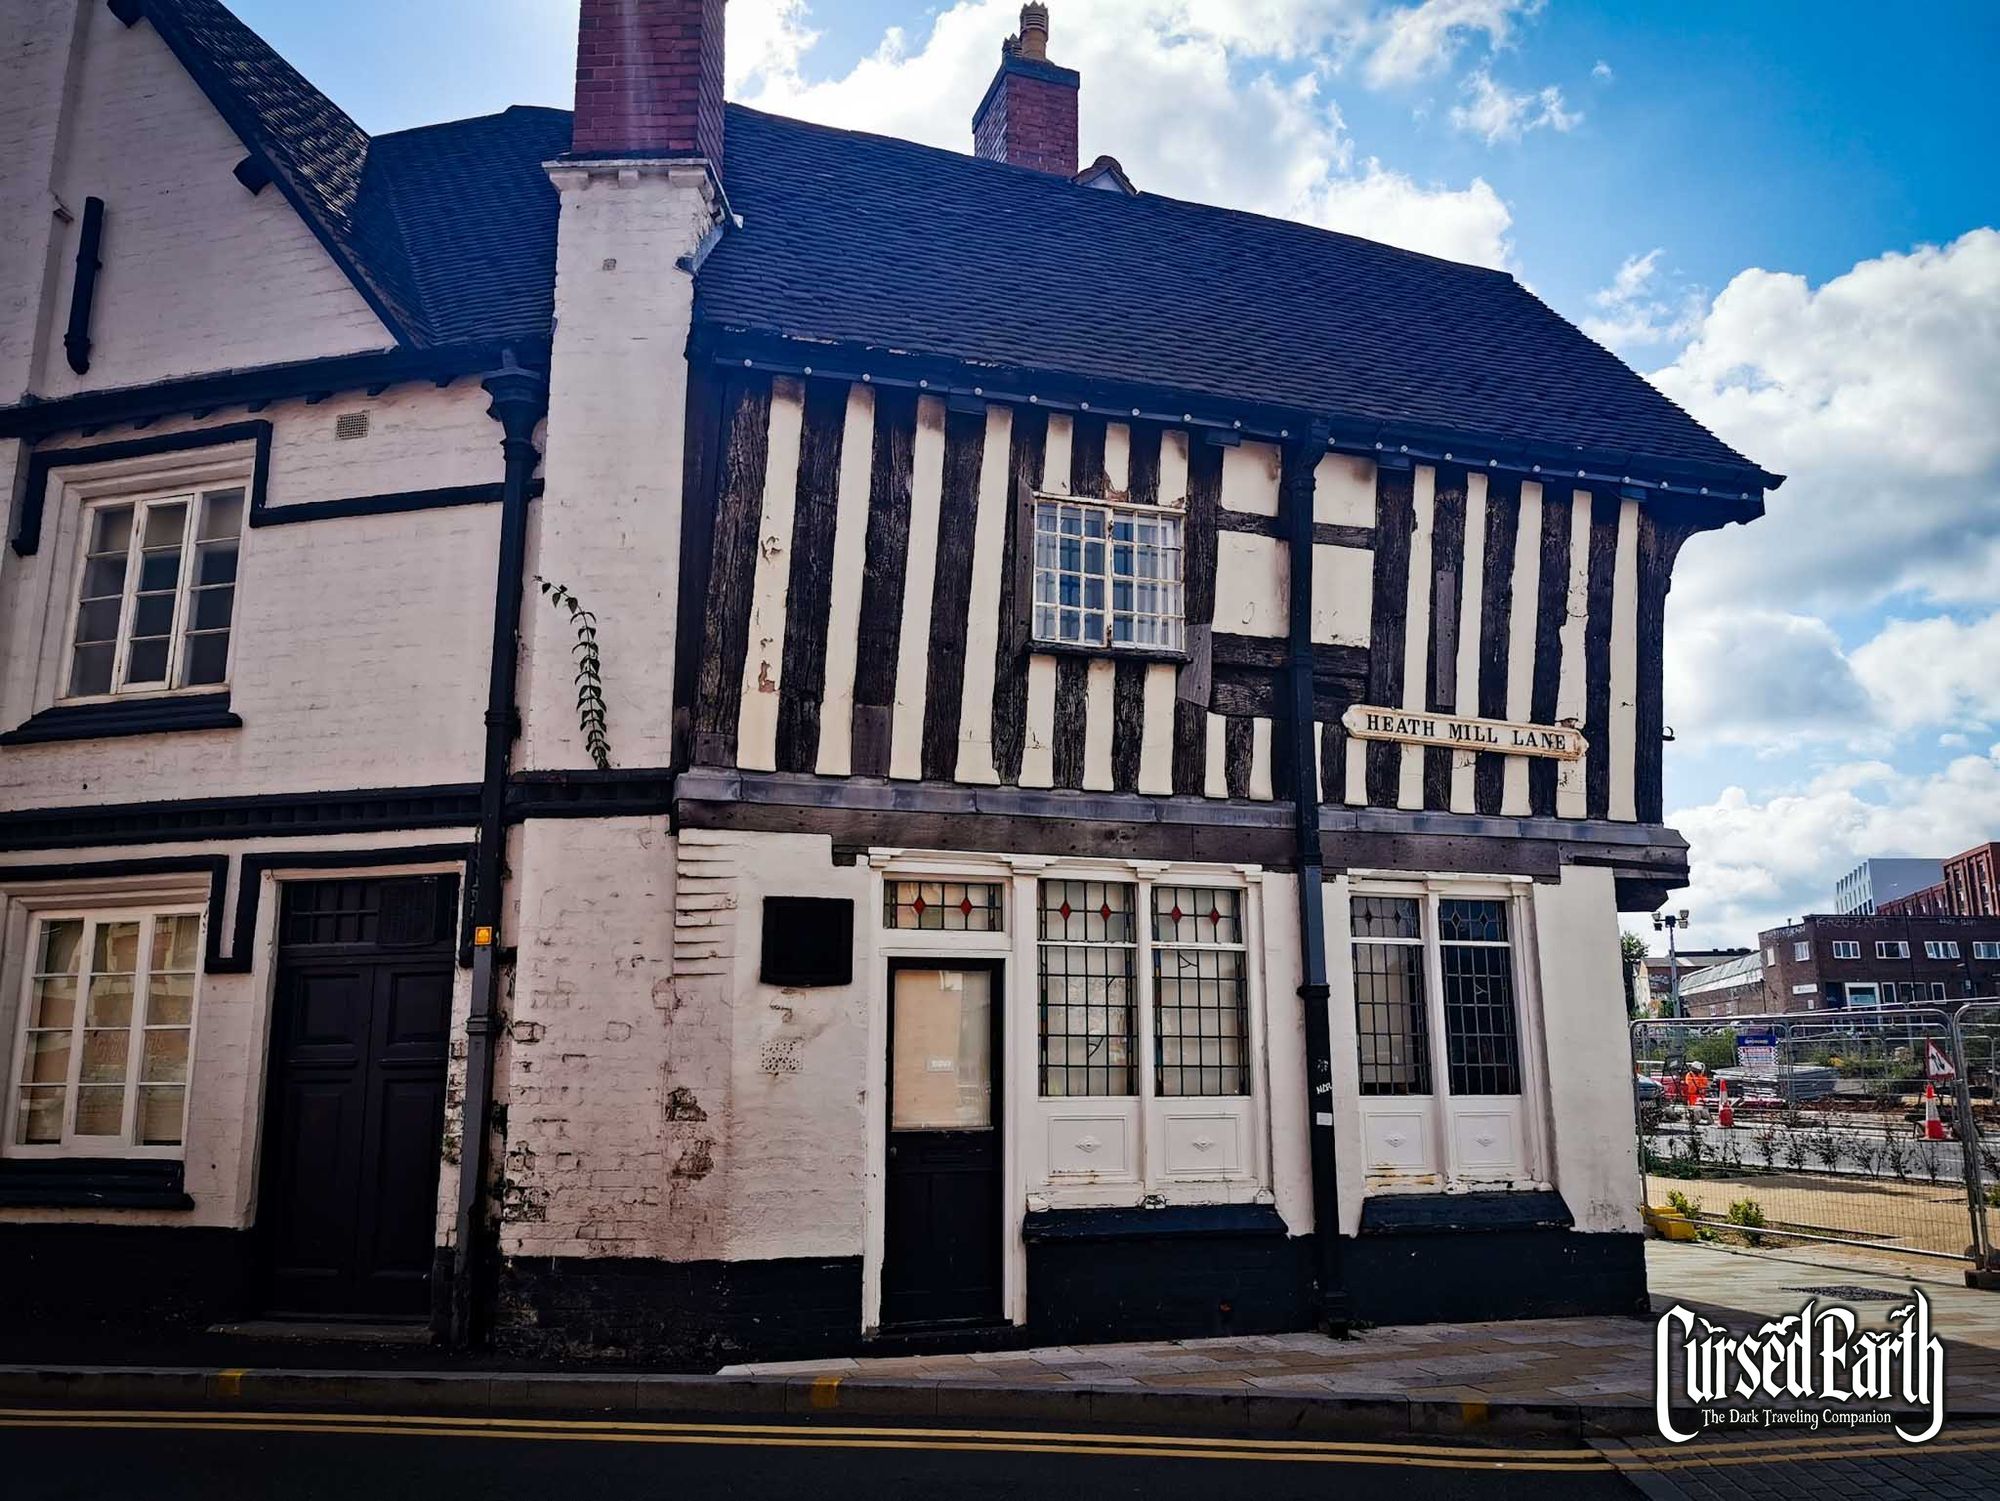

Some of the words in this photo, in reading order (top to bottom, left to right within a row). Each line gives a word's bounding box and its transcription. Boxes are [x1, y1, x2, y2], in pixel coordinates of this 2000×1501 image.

[1367, 714, 1435, 737] HEATH
[1449, 723, 1498, 744] MILL
[1513, 730, 1566, 750] LANE
